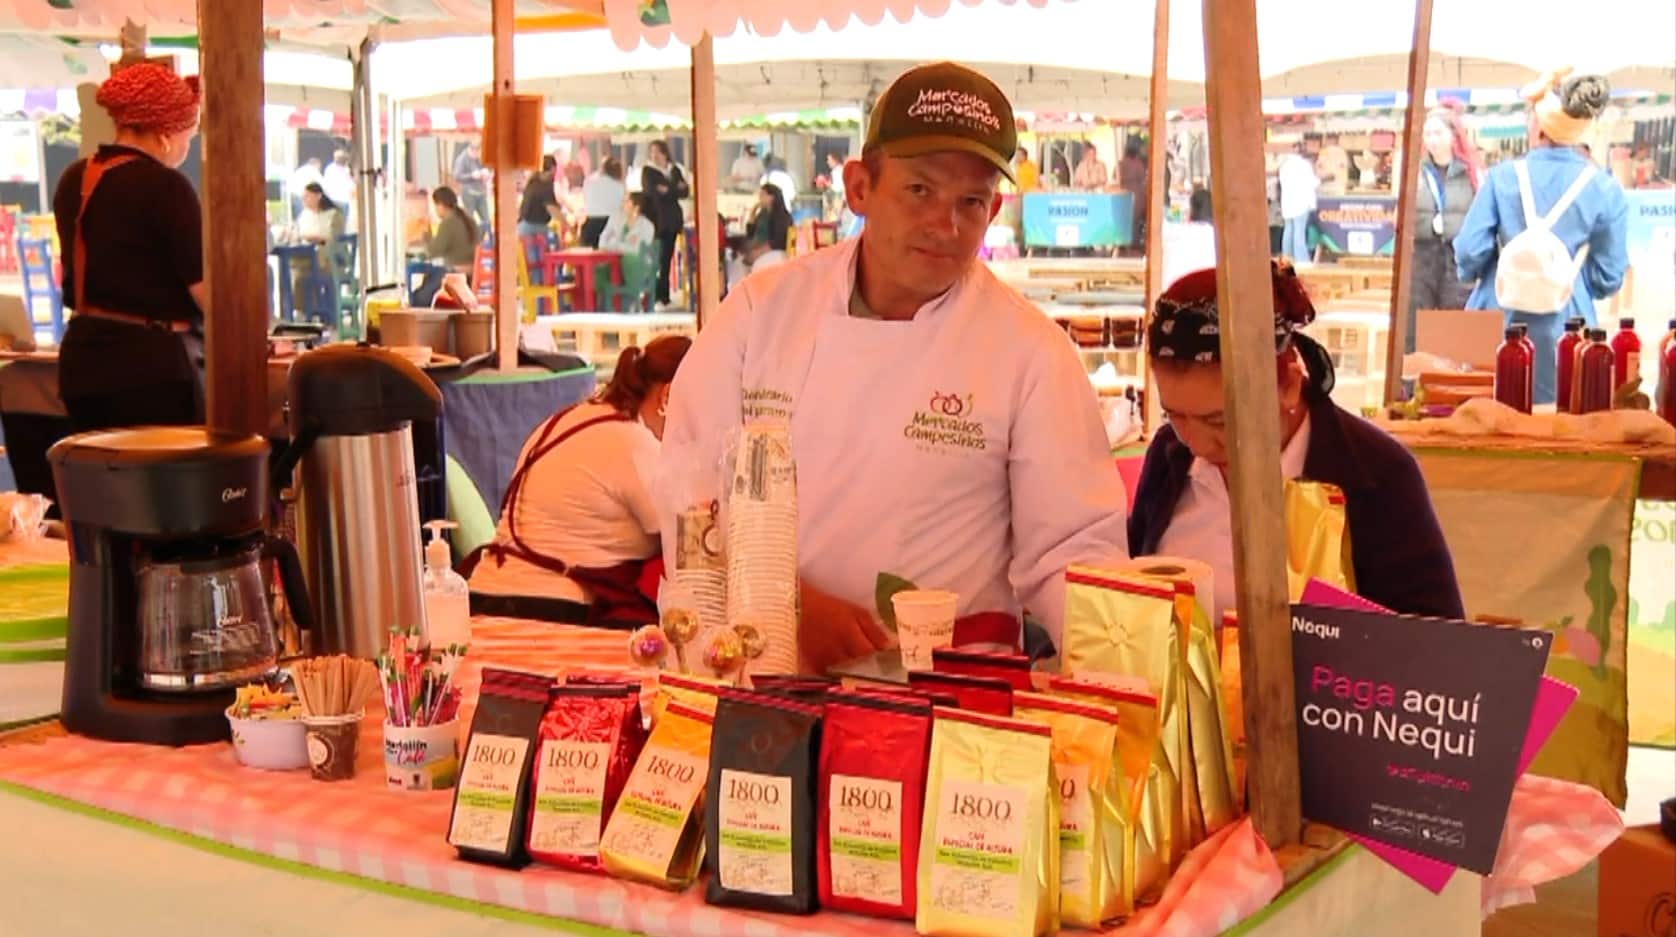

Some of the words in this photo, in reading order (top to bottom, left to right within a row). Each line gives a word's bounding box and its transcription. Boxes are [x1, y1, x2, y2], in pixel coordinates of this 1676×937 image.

[917, 88, 991, 114] Mercados
[904, 425, 986, 449] Campesinos
[912, 411, 984, 436] Mercados
[1291, 616, 1340, 639] Nequi
[1311, 665, 1396, 710] Paga
[1402, 688, 1482, 725] aquí
[1302, 703, 1364, 736] con
[1373, 709, 1476, 760] Nequi
[473, 744, 516, 767] 1800
[548, 747, 599, 770] 1800
[647, 754, 695, 783] 1800
[728, 778, 780, 806] 1800
[840, 783, 893, 811] 1800
[950, 792, 1012, 821] 1800
